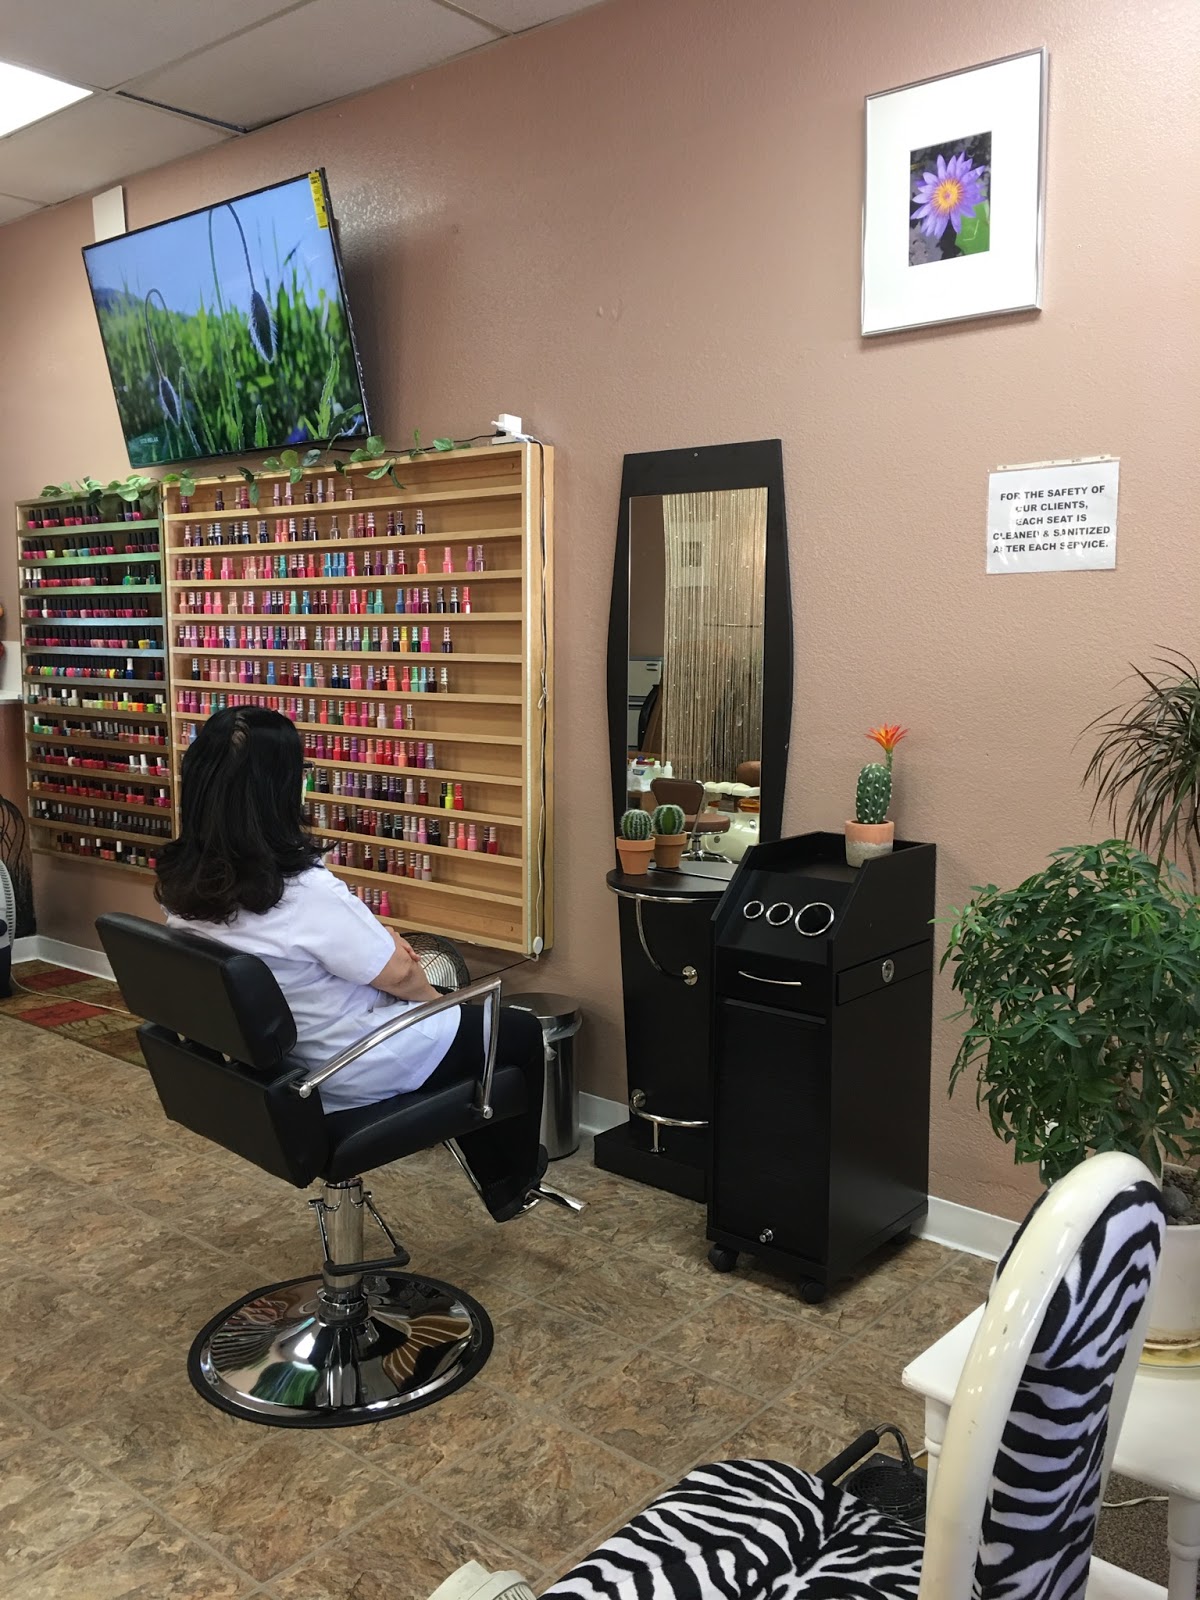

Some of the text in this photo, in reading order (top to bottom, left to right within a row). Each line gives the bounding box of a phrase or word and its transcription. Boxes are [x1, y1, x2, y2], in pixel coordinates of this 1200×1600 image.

[1000, 485, 1105, 501] FOR THE SAFETY OF
[1040, 500, 1088, 511] CLIENTS,
[1046, 514, 1073, 524] SEAT
[1077, 513, 1087, 522] IS
[1053, 526, 1110, 537] SANITIZED
[1028, 543, 1056, 552] EACH
